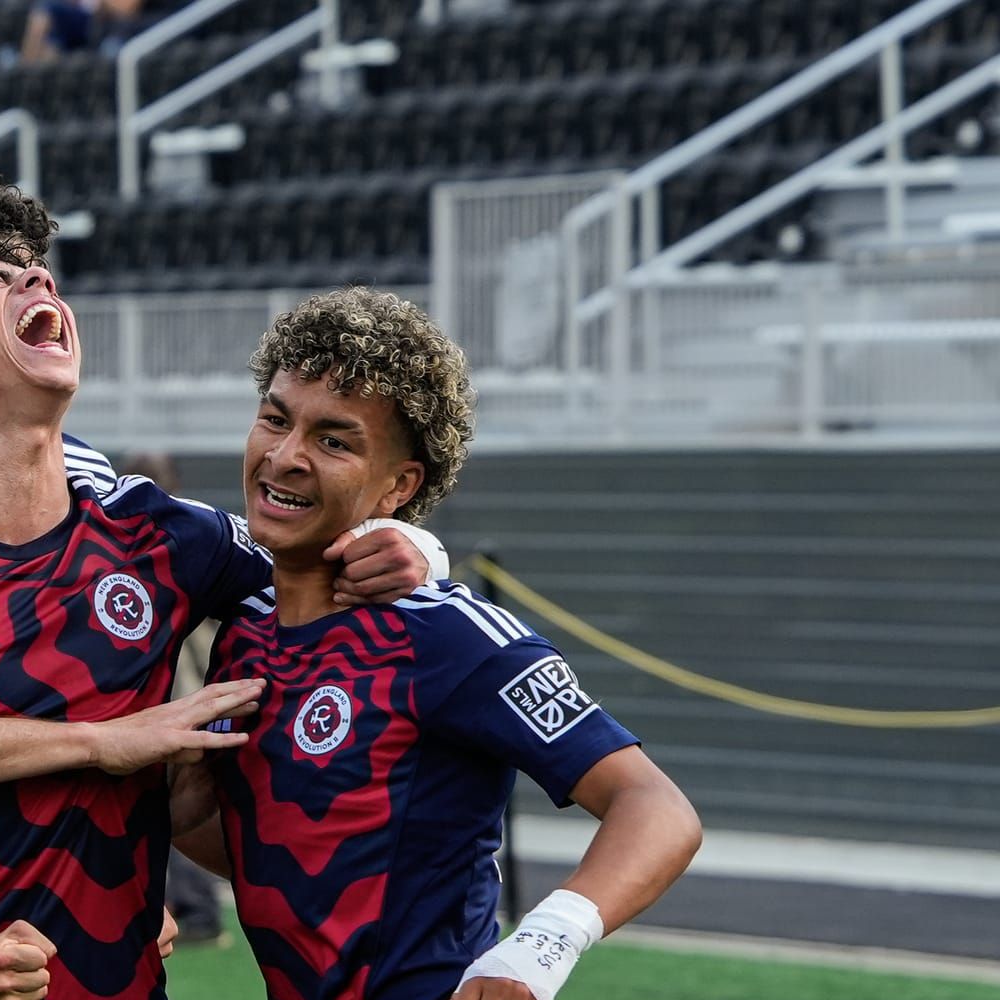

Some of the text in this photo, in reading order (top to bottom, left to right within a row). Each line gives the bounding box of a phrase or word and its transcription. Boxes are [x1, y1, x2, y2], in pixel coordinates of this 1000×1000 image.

[109, 576, 140, 590] ENGLAND
[111, 624, 147, 637] REVOLUTION
[322, 688, 347, 705] ENGLAND
[511, 687, 537, 712] MLS
[298, 734, 332, 751] REVOLUTION
